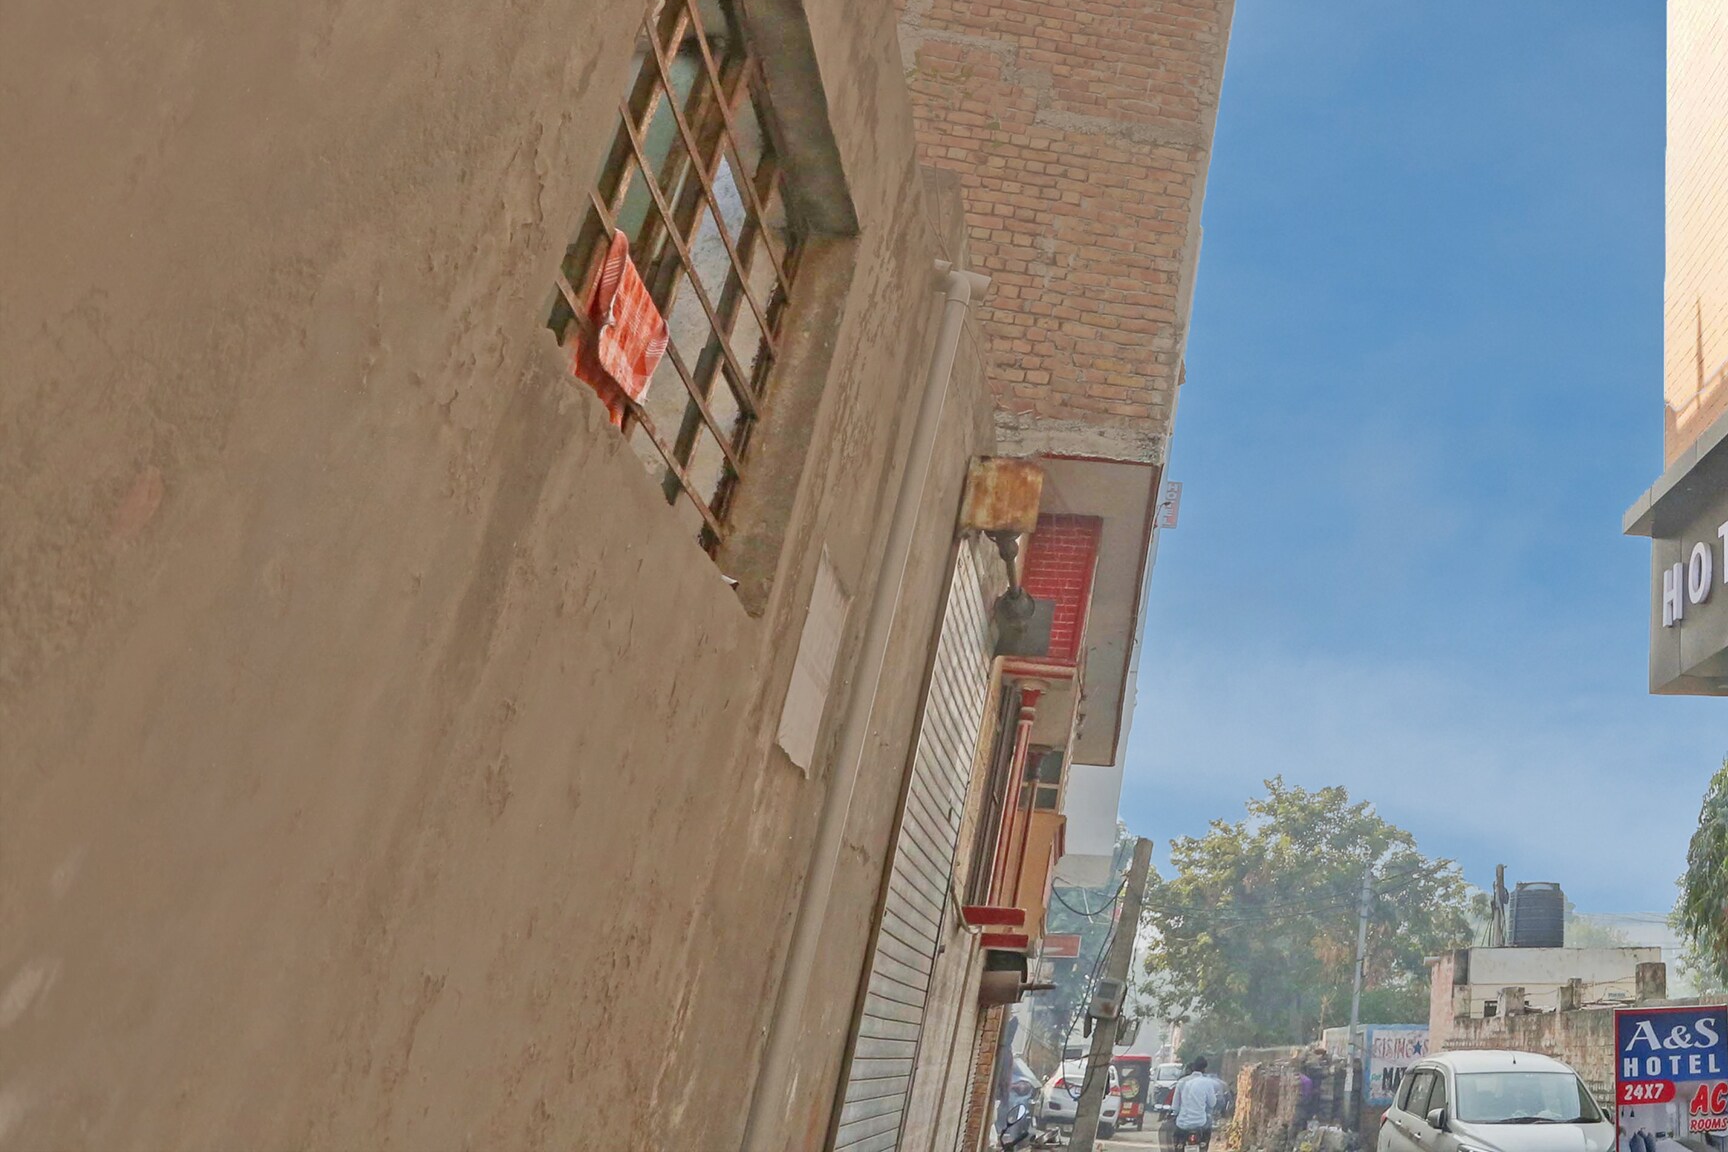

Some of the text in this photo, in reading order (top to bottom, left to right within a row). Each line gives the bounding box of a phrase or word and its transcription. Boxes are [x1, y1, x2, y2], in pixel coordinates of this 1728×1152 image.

[1625, 1017, 1719, 1051] A&S
[1624, 1053, 1720, 1078] HOTEL
[1624, 1082, 1664, 1101] 24X7
[1690, 1082, 1728, 1115] AC
[1690, 1117, 1728, 1132] ROOMS
